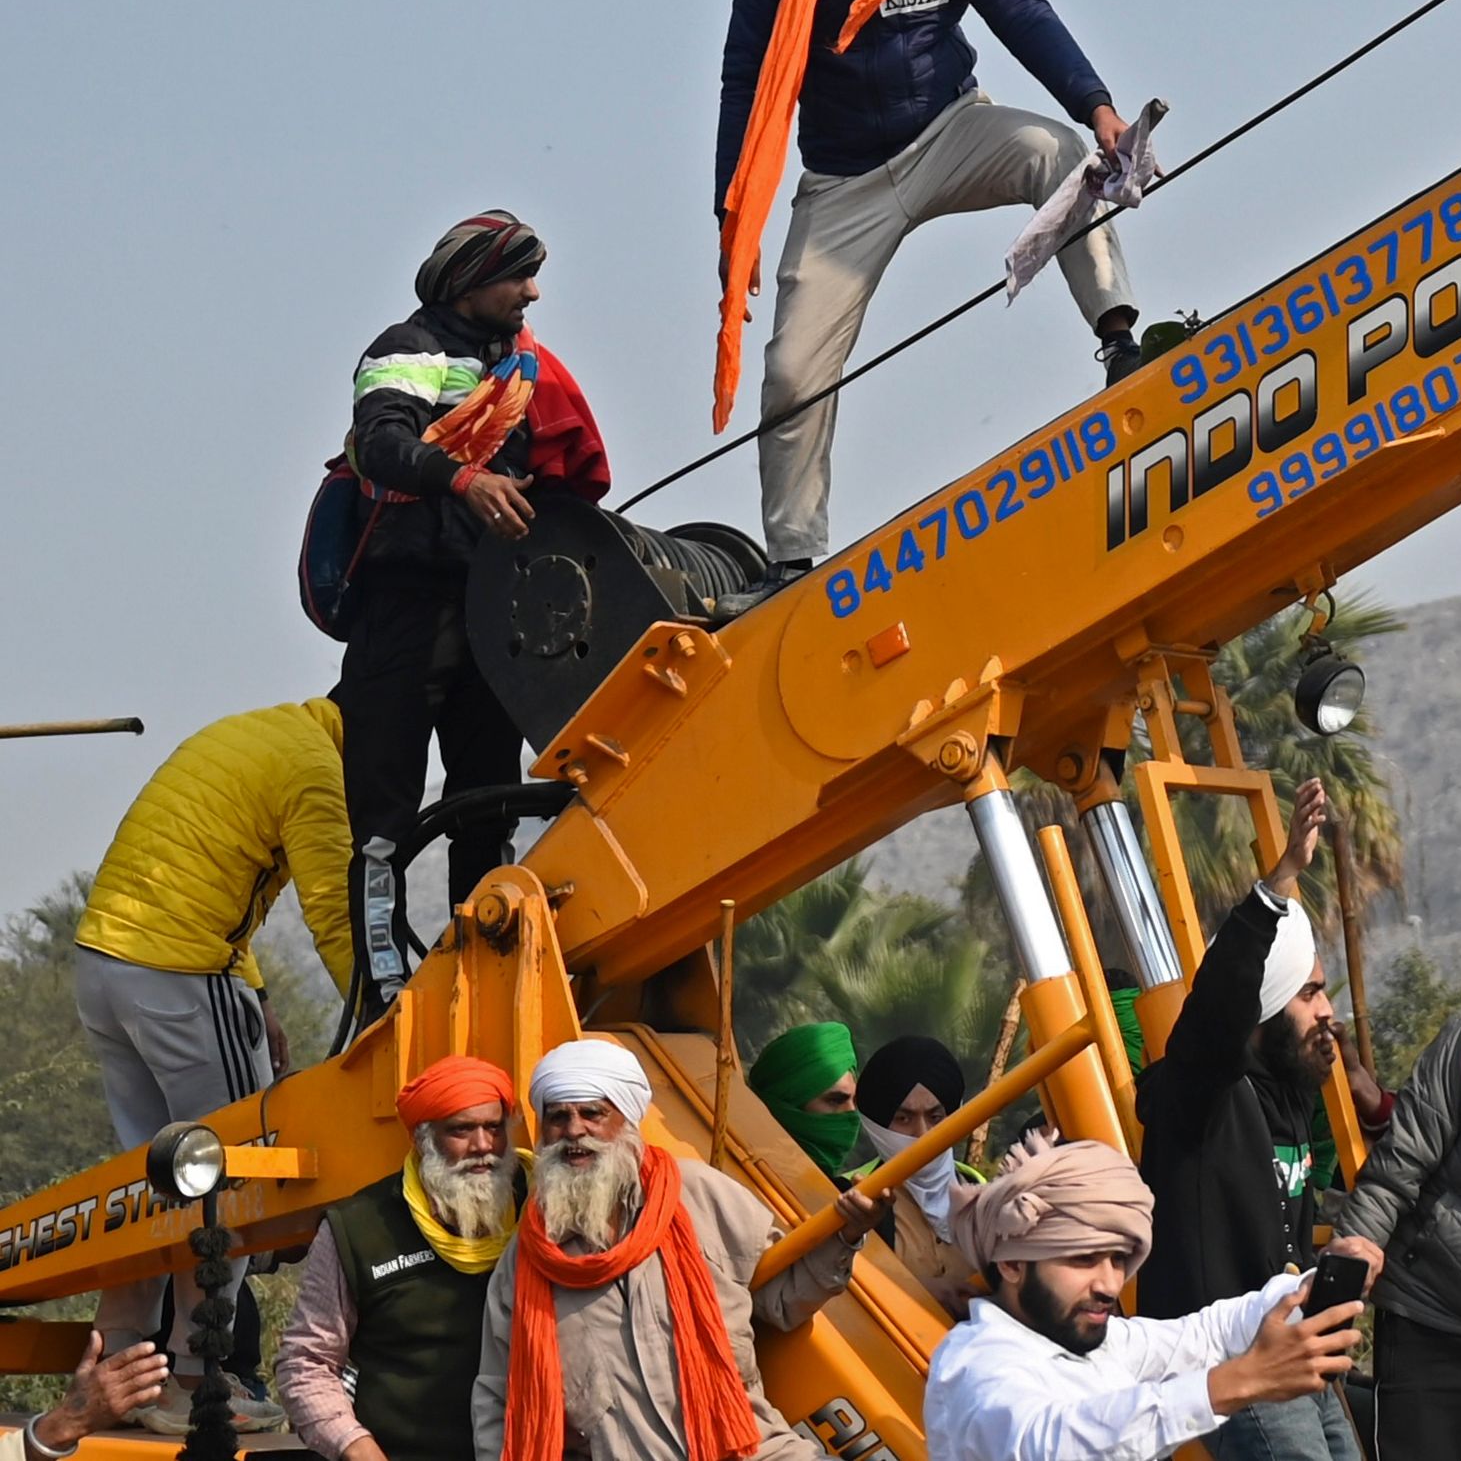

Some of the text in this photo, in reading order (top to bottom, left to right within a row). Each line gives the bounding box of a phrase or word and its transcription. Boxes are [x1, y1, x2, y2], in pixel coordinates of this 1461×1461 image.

[825, 411, 1117, 618] 8447029118
[369, 869, 400, 976] PUMA
[371, 1249, 436, 1280] INDIAN FARMERS
